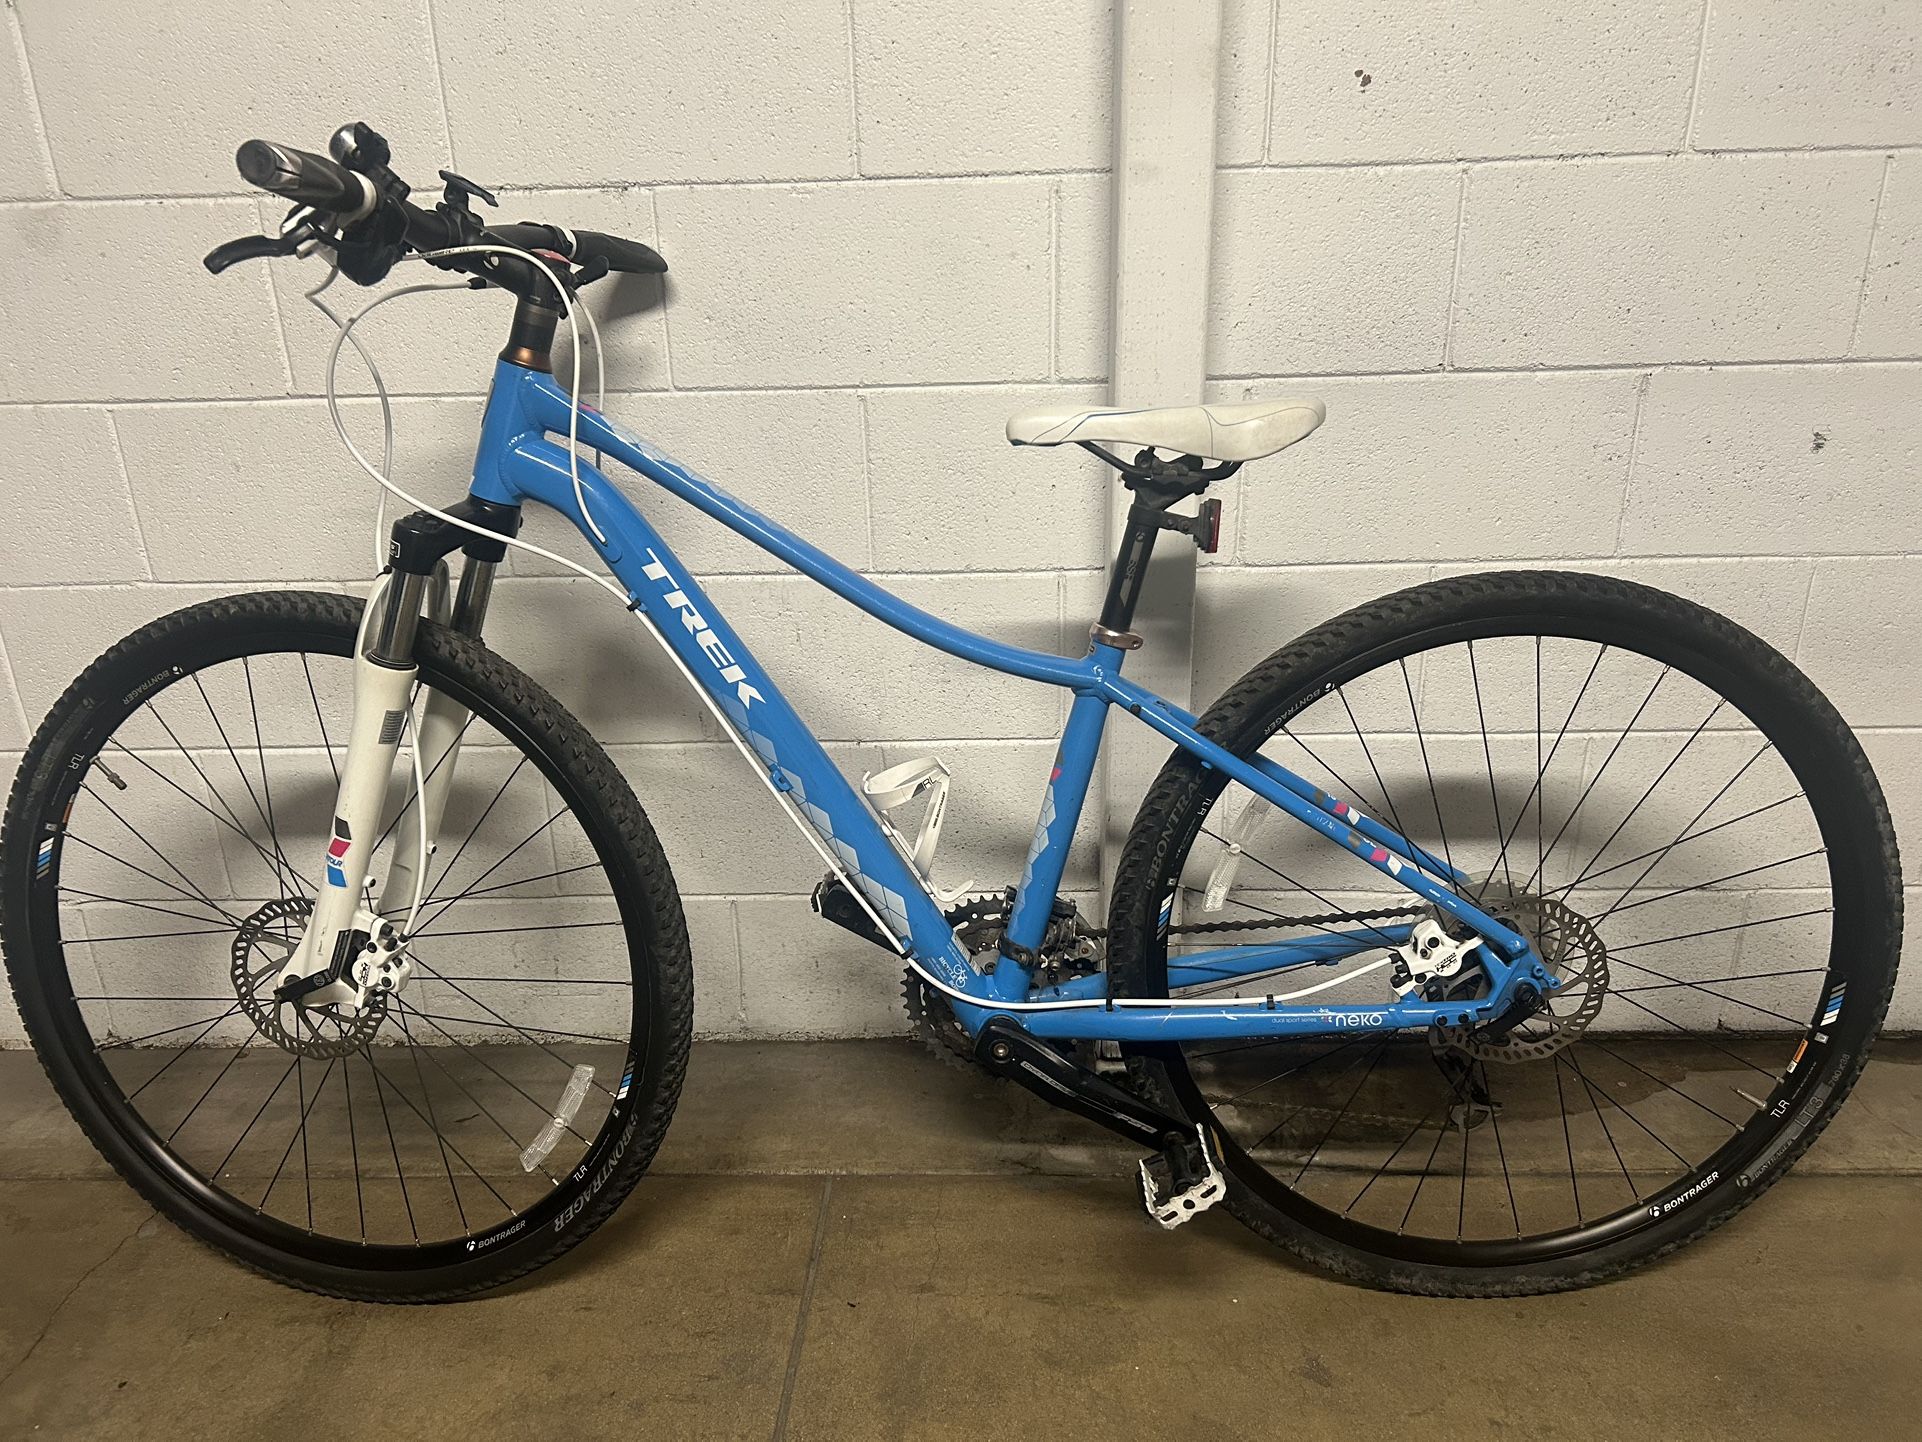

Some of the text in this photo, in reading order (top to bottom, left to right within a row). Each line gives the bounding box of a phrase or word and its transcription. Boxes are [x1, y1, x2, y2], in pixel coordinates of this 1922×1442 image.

[641, 547, 767, 710] TREK
[122, 669, 170, 705] BONTRAGER
[1263, 687, 1322, 736] BONTRAGER
[67, 752, 85, 771] TLR
[922, 776, 937, 790] RL
[1152, 770, 1202, 869] BONTRA
[1196, 797, 1214, 818] TLR
[938, 956, 958, 980] BICYCLE
[1285, 1016, 1300, 1024] sport
[1335, 1014, 1383, 1027] neko
[1769, 1099, 1790, 1119] TLR
[554, 1127, 632, 1233] BONTRAGER
[572, 1164, 588, 1183] TLR
[1663, 1170, 1720, 1213] BONTRAGER
[477, 1220, 526, 1249] BONTRAGER
